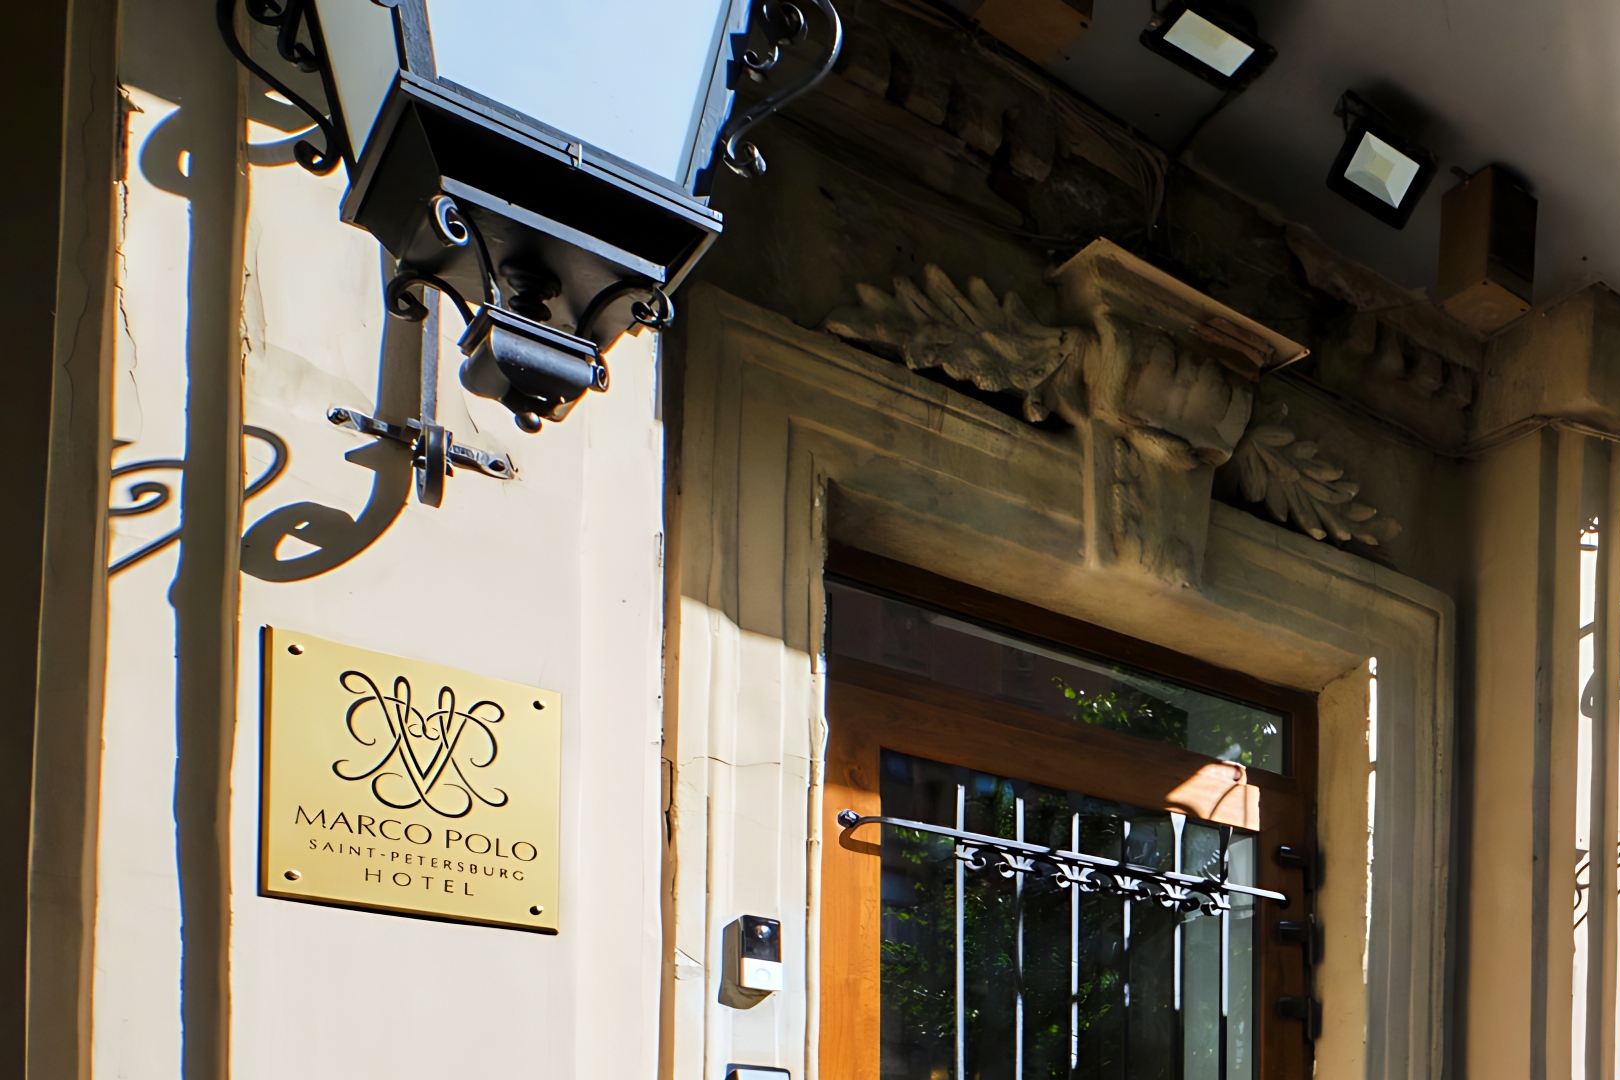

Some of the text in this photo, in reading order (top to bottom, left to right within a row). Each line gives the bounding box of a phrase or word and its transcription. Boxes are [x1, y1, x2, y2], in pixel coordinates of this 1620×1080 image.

[294, 805, 538, 862] MARCO POLO
[309, 838, 525, 881] SAINT-PETERSBURG
[364, 867, 475, 896] HOTEL
